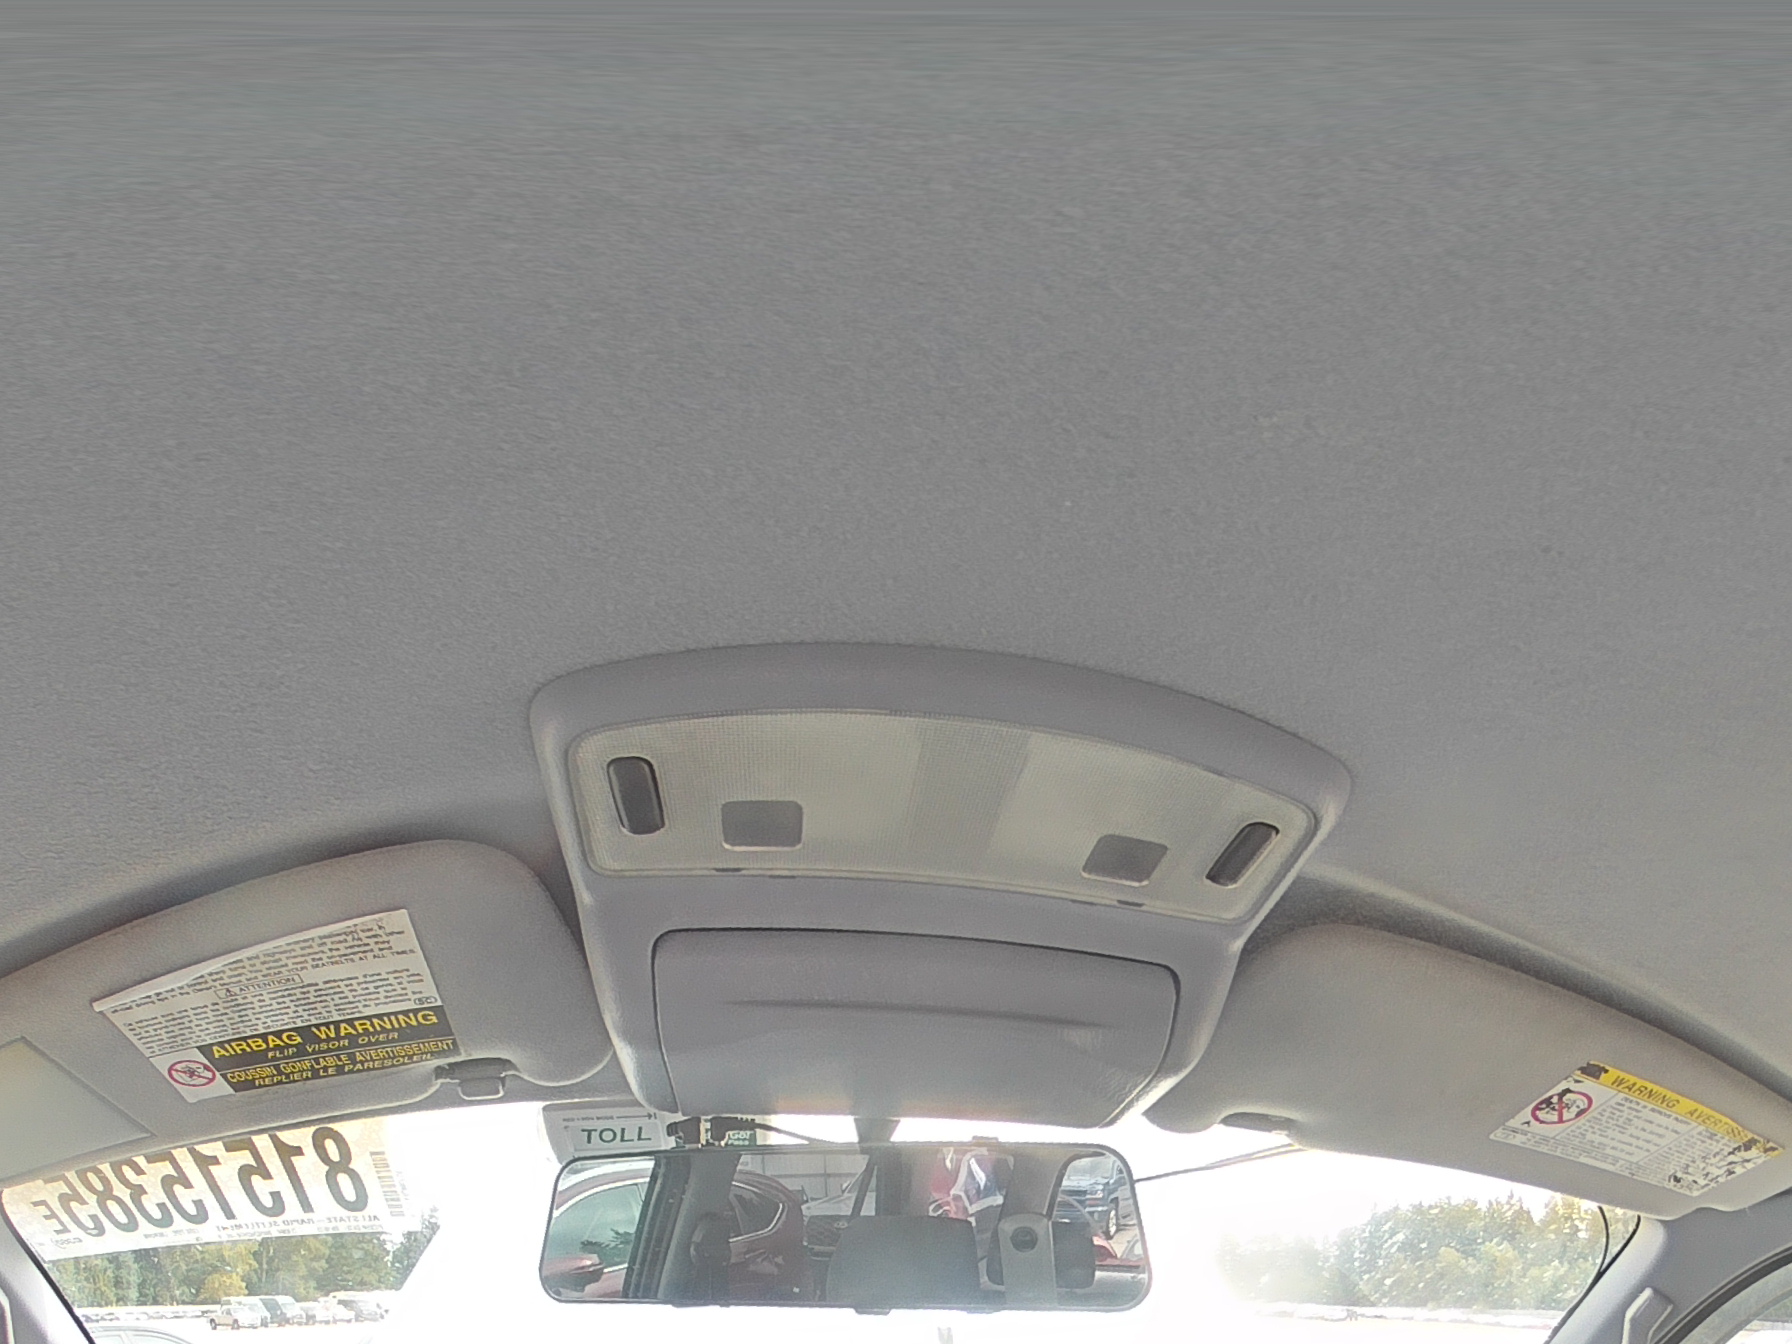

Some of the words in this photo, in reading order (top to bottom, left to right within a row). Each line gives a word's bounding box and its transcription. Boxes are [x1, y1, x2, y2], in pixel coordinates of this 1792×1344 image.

[238, 976, 296, 994] ATTENTION
[212, 1031, 303, 1059] AIRBAG
[311, 1010, 439, 1040] WARNING
[268, 1047, 297, 1059] FLIP
[306, 1039, 349, 1053] VISOR
[358, 1031, 399, 1045] OVER
[226, 1065, 278, 1083] COUSSIN
[280, 1053, 351, 1074] GONFLABLE
[355, 1038, 454, 1062] AVERTISSEMENT
[255, 1070, 312, 1087] REPLIER
[319, 1065, 337, 1077] LE
[1611, 1075, 1680, 1109] WARNING
[581, 1126, 652, 1145] TOLL
